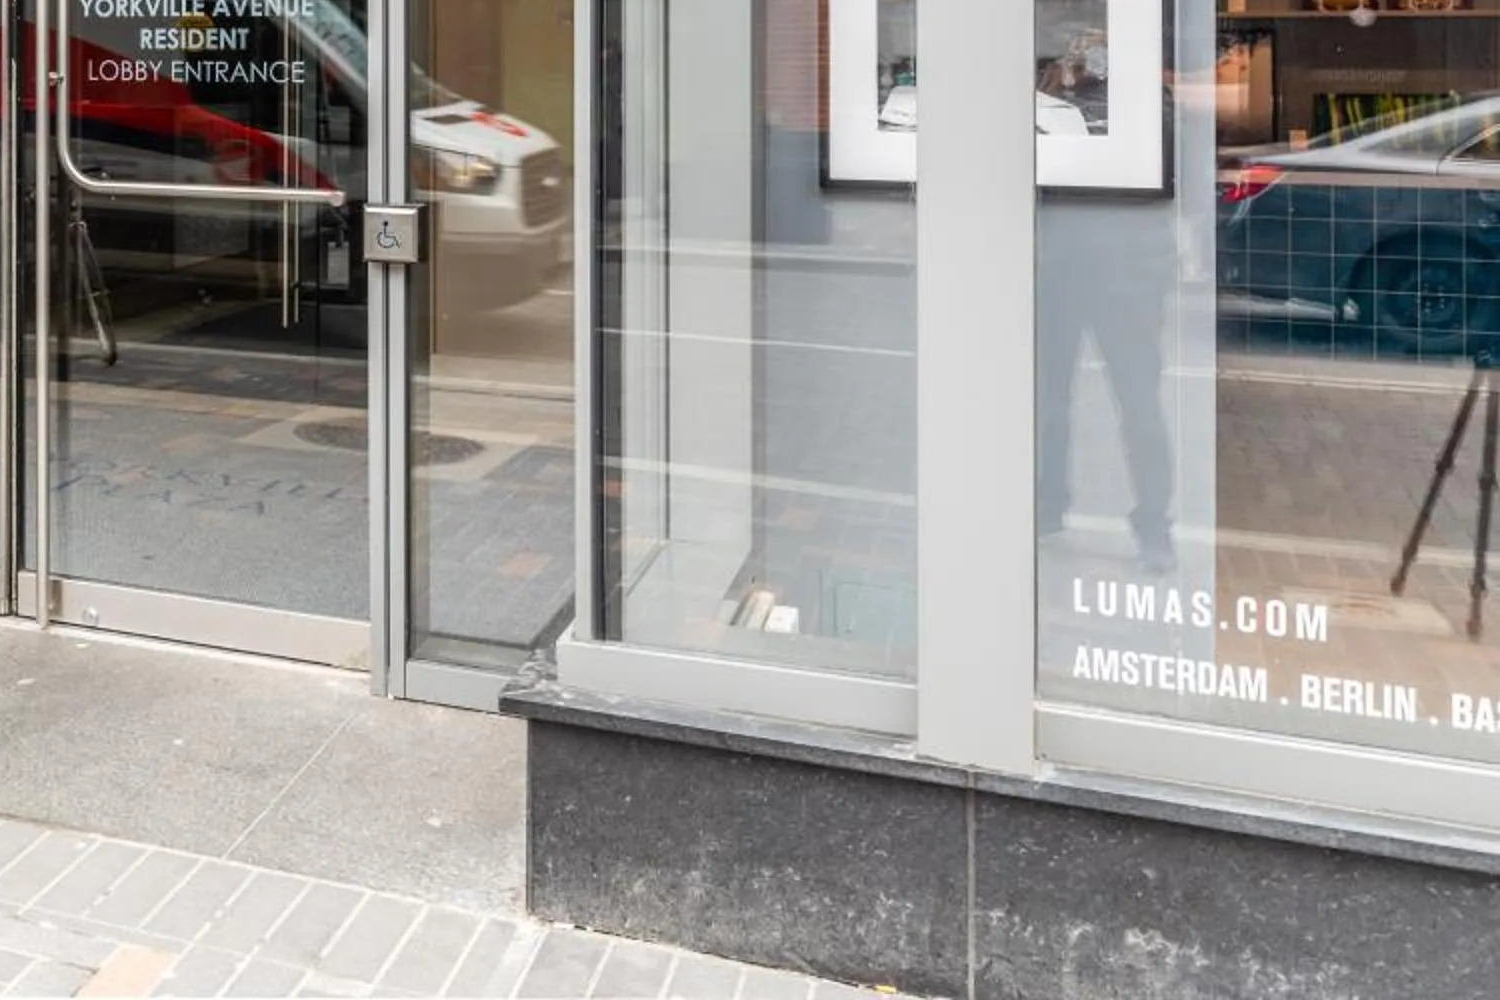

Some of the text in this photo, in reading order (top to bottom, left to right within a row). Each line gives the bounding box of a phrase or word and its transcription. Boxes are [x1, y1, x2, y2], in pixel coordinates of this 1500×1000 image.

[139, 27, 250, 51] RESIDENT
[87, 59, 306, 83] LOBBY ENTRANCE
[1072, 577, 1328, 642] LUMAS.COM
[1072, 646, 1268, 703] AMSTERDAM
[1301, 674, 1417, 724] BERLIN
[1451, 692, 1500, 734] BA
